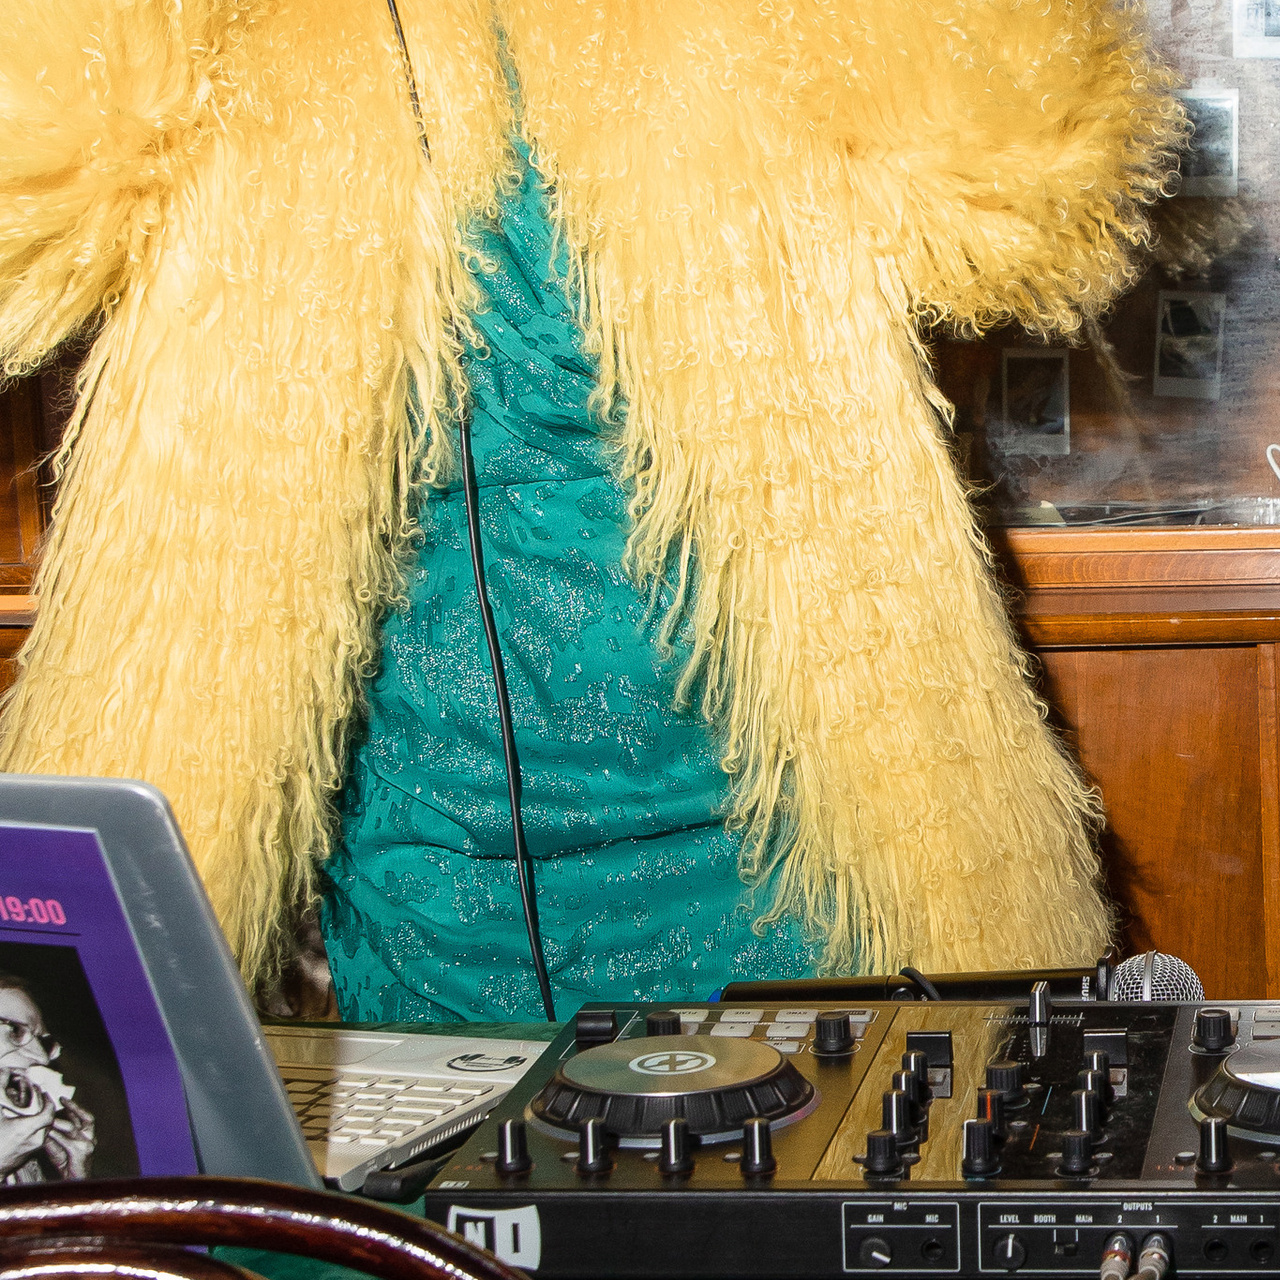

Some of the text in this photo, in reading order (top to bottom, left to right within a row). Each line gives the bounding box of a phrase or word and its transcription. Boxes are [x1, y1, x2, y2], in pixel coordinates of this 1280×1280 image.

[893, 1202, 908, 1211] MIC
[1123, 1202, 1153, 1211] OUTPUTS
[867, 1214, 939, 1223] GAIN MIC
[999, 1214, 1020, 1224] LEVEL
[1033, 1214, 1057, 1224] BOOTH
[1075, 1214, 1093, 1224] MAIN
[1230, 1214, 1248, 1224] MAIN
